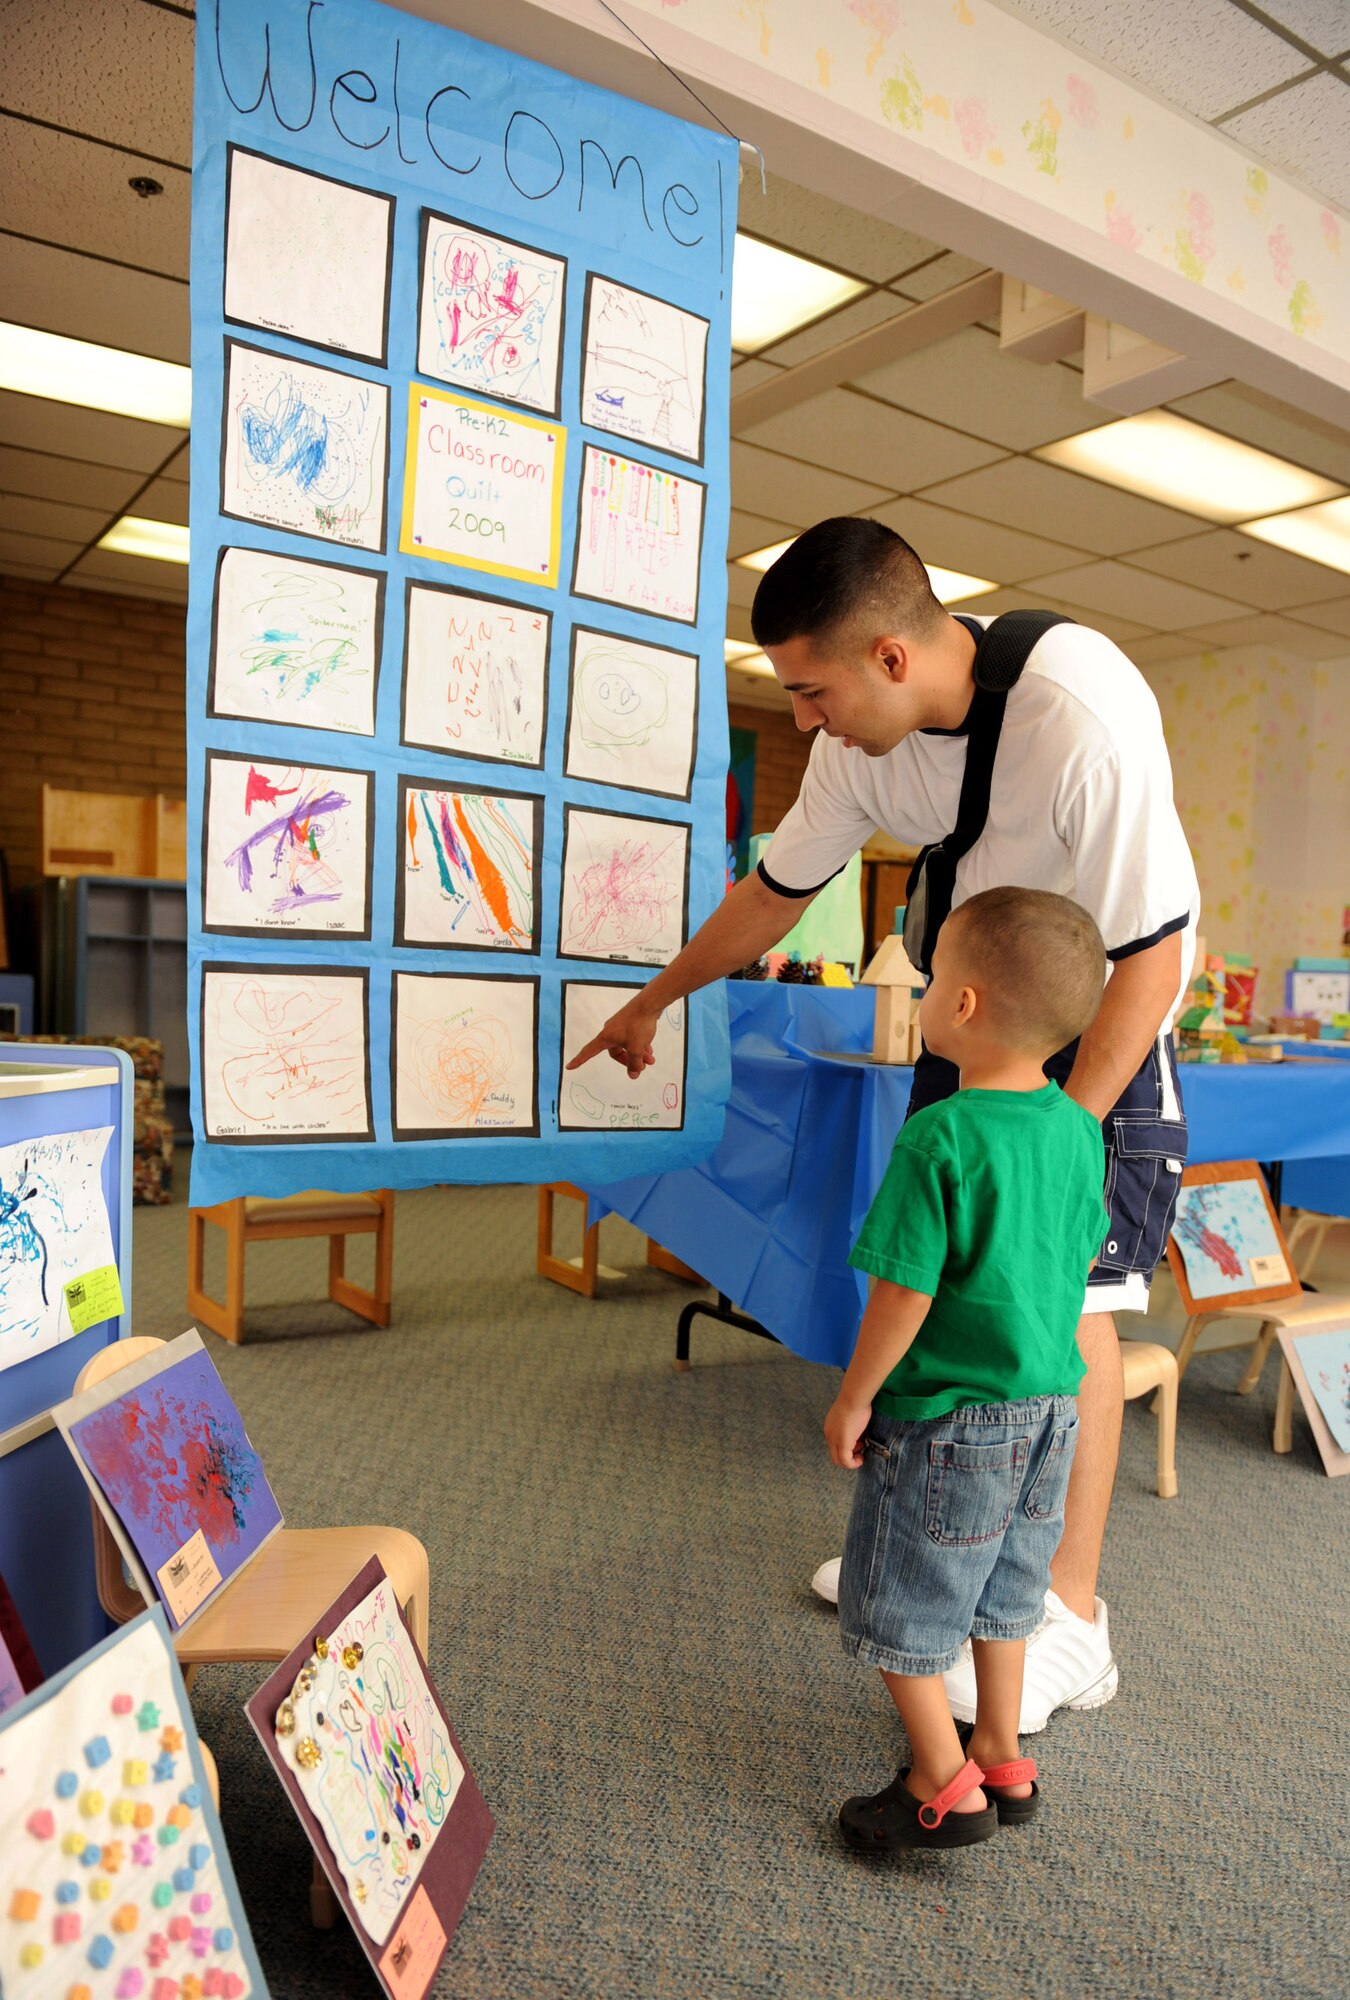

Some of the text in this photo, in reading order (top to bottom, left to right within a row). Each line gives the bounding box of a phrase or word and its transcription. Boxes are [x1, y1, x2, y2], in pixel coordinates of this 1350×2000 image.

[455, 407, 510, 437] Pre-K2
[427, 424, 546, 484] Classroom
[446, 476, 502, 503] Quilt
[448, 507, 506, 544] 2009
[501, 748, 534, 762] Isabelle
[216, 1125, 246, 1135] Gabriel
